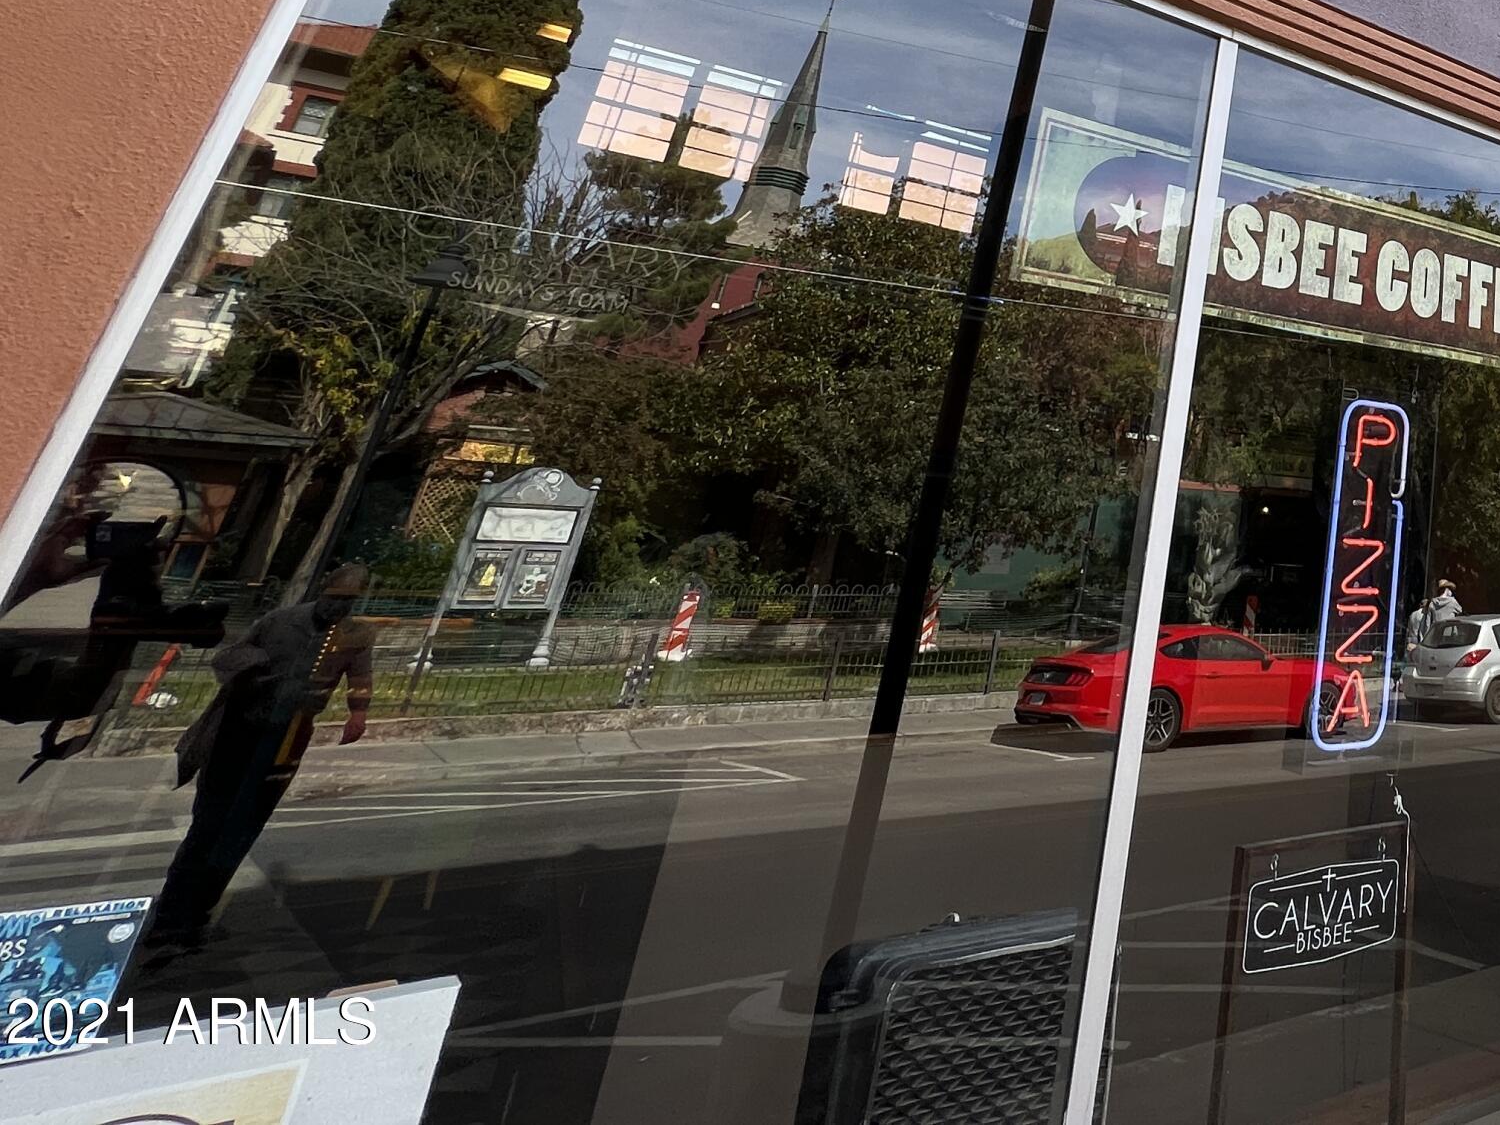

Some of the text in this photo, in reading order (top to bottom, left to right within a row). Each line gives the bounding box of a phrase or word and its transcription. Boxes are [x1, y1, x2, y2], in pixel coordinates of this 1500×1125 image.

[1326, 413, 1398, 733] PIZZA
[53, 900, 147, 917] RELAXATION
[1253, 879, 1394, 940] CALVARY
[0, 938, 28, 962] BS
[1295, 921, 1353, 954] BISBEE
